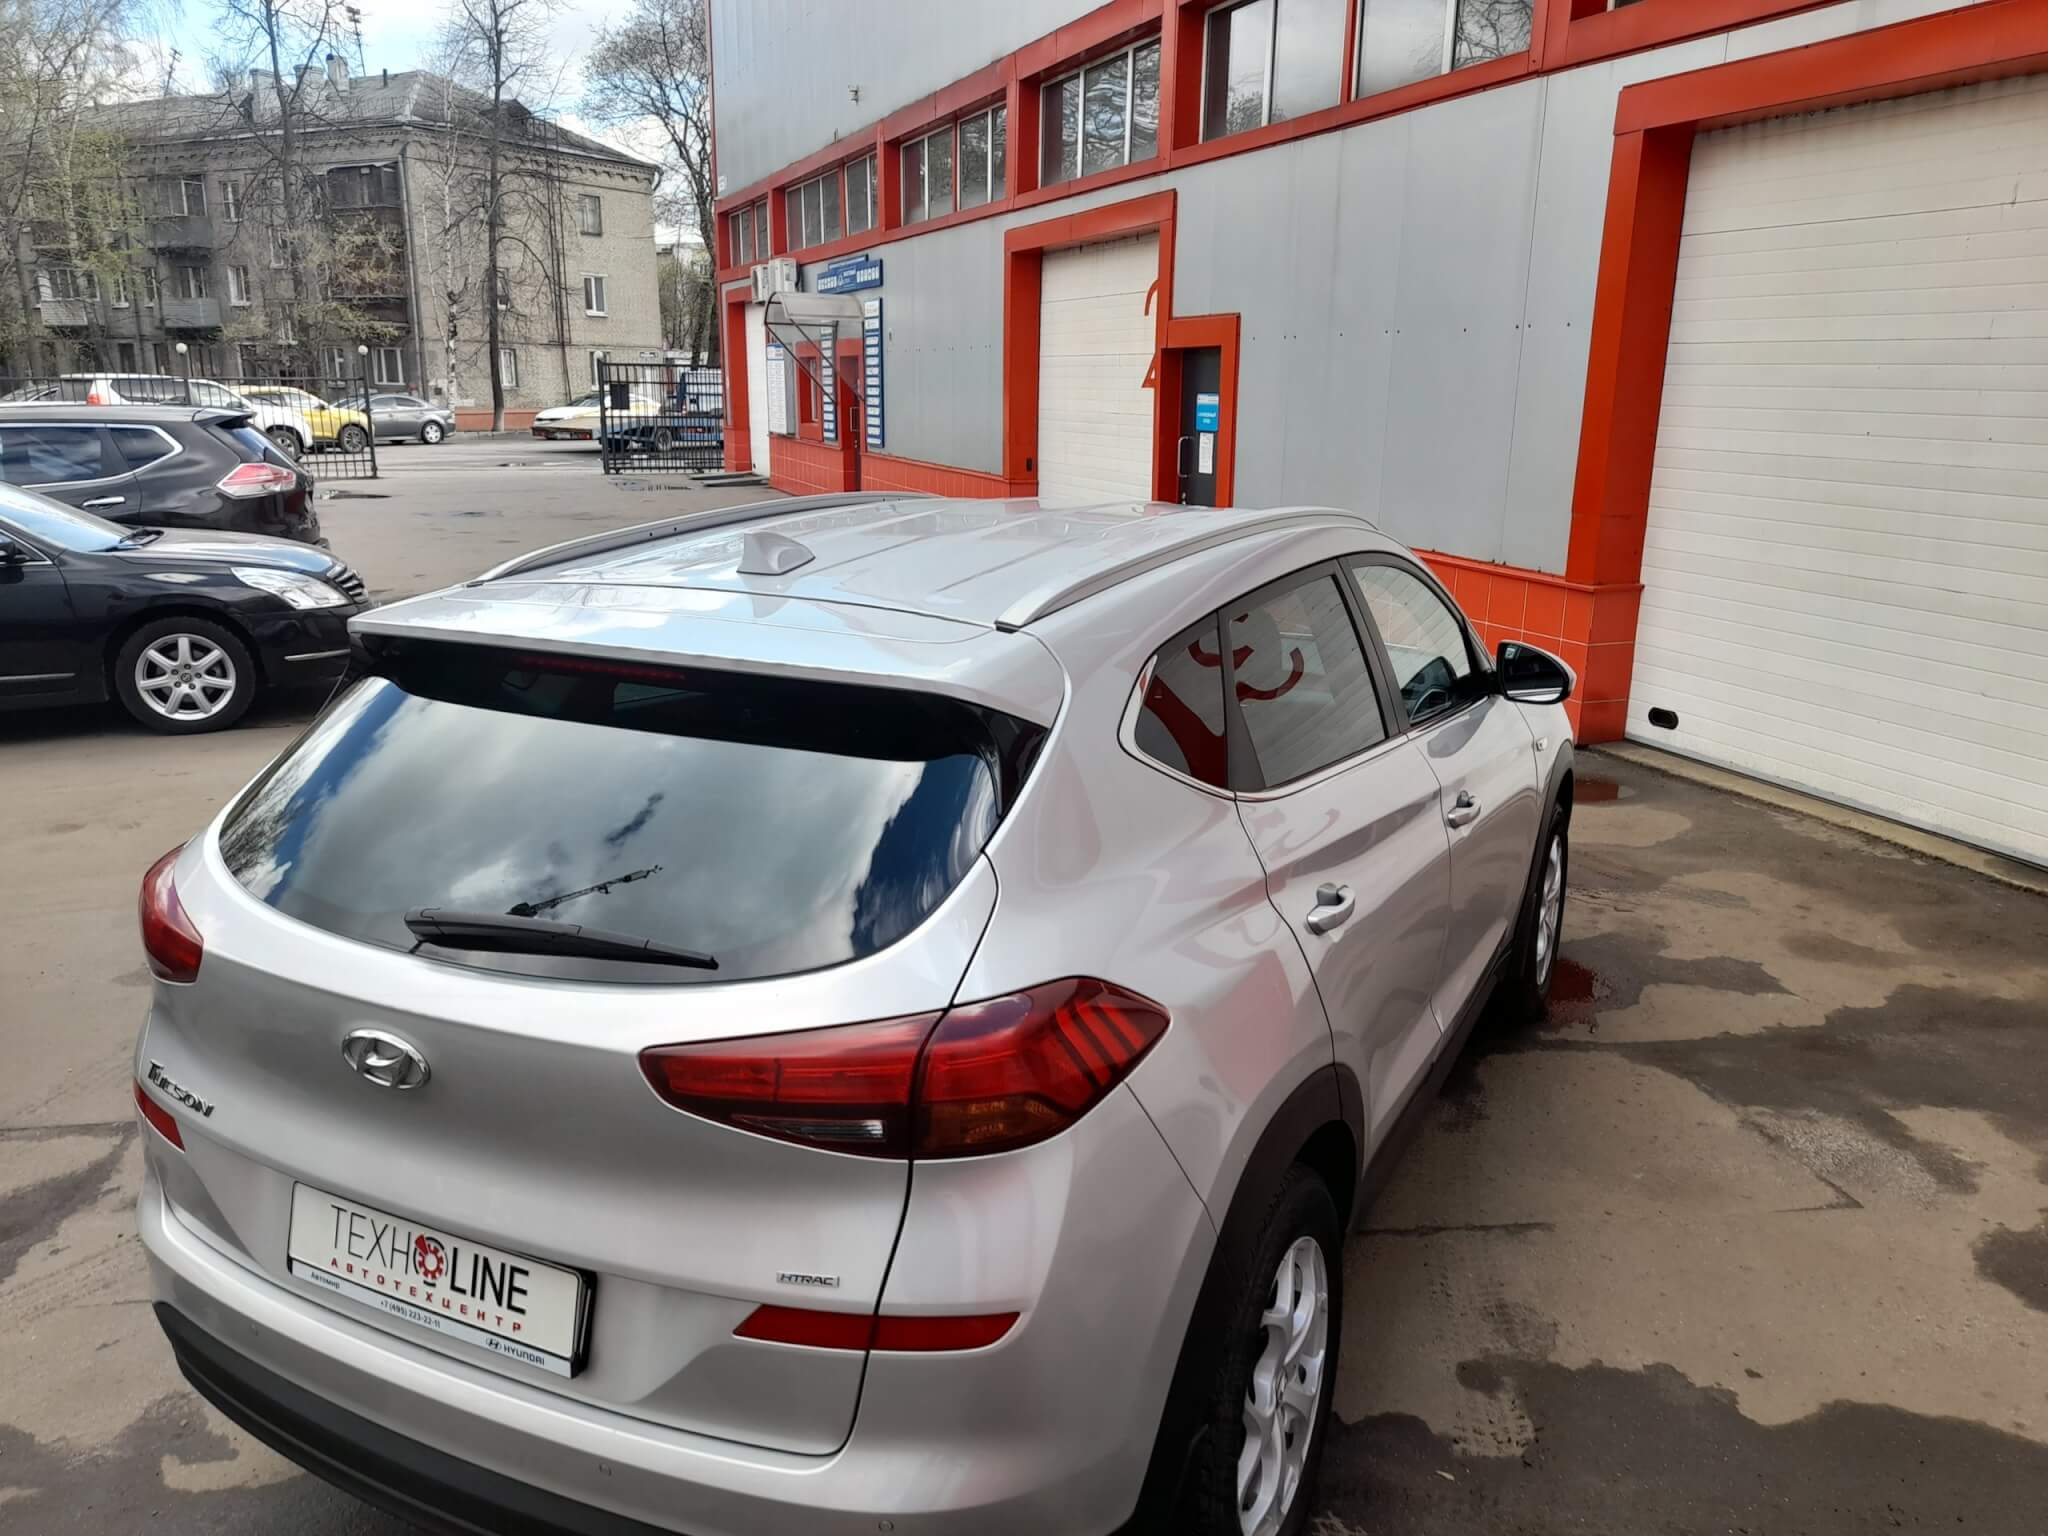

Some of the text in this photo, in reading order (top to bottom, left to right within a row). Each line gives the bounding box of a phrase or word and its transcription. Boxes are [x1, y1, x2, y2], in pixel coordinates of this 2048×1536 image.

[778, 1272, 837, 1287] HTRAC
[330, 1258, 522, 1332] АВТОТЕХЦЕНТР
[503, 1343, 545, 1366] HYUNDAI
